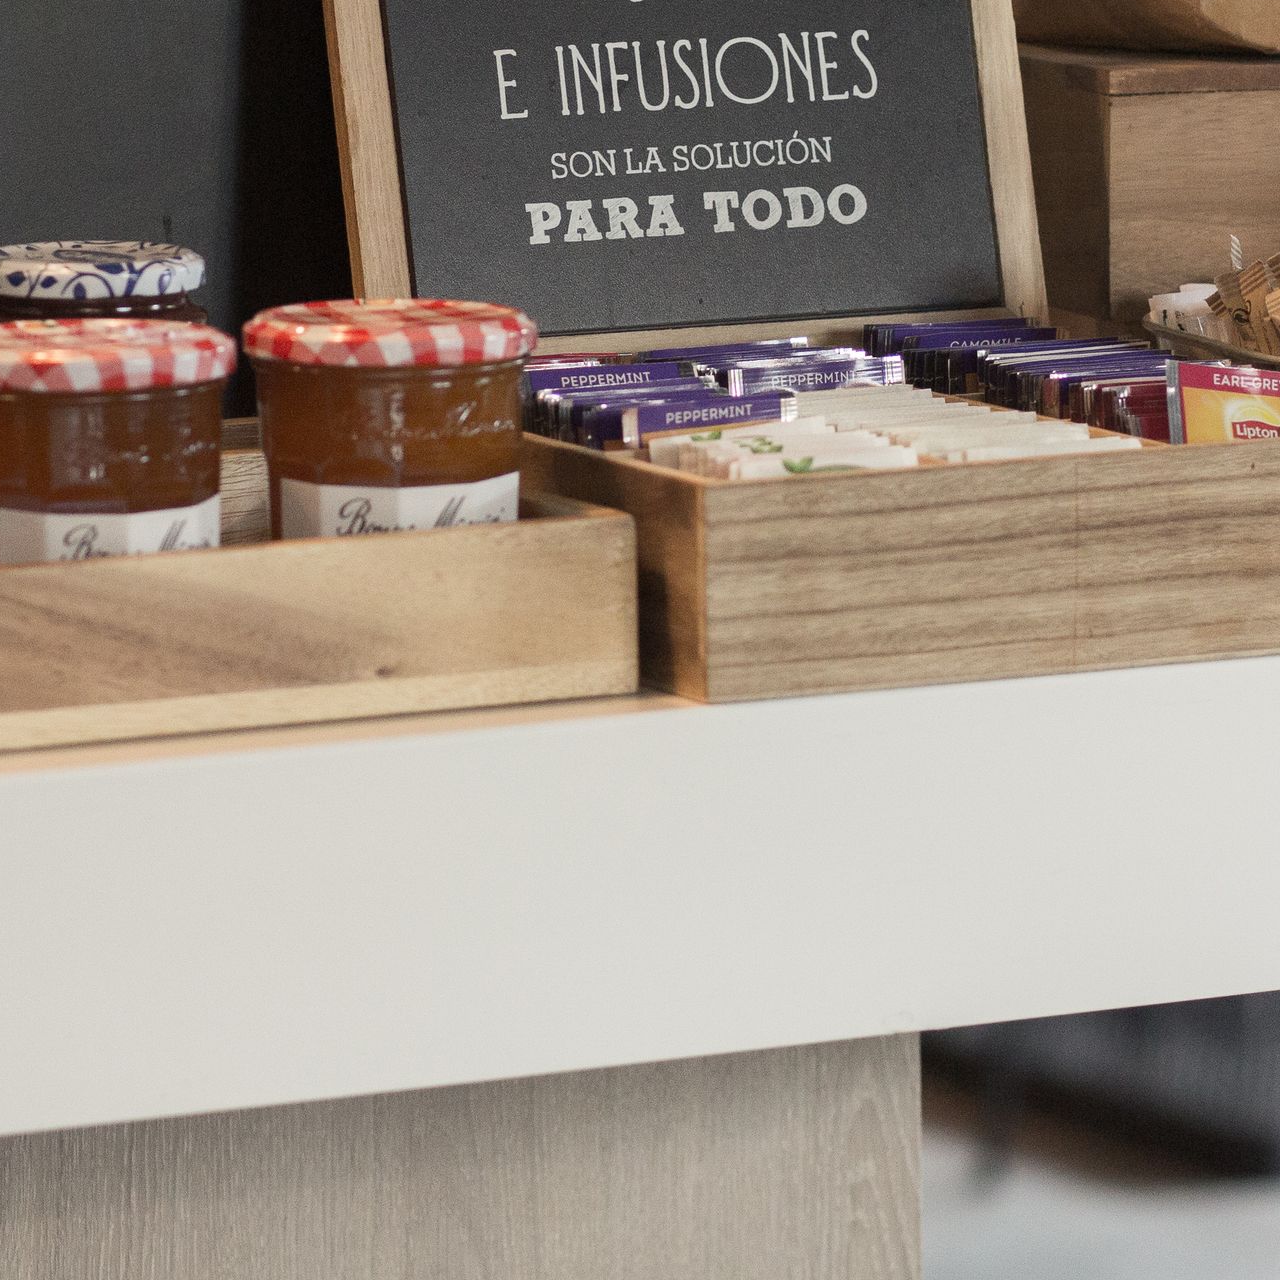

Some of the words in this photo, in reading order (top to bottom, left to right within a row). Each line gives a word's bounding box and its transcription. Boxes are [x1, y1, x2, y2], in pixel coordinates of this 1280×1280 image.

[492, 48, 528, 120] E
[554, 28, 879, 117] INFUSIONES
[551, 149, 616, 180] SON
[624, 146, 667, 175] LA
[672, 130, 833, 173] SOLUCIÓN
[524, 193, 686, 246] PARA
[703, 182, 868, 234] TODO
[560, 370, 651, 389] PEPPERMINT
[771, 370, 857, 388] PEPPERMINT
[1213, 373, 1247, 388] EARL
[665, 404, 754, 425] PEPPERMINT
[1235, 423, 1279, 439] Lipton
